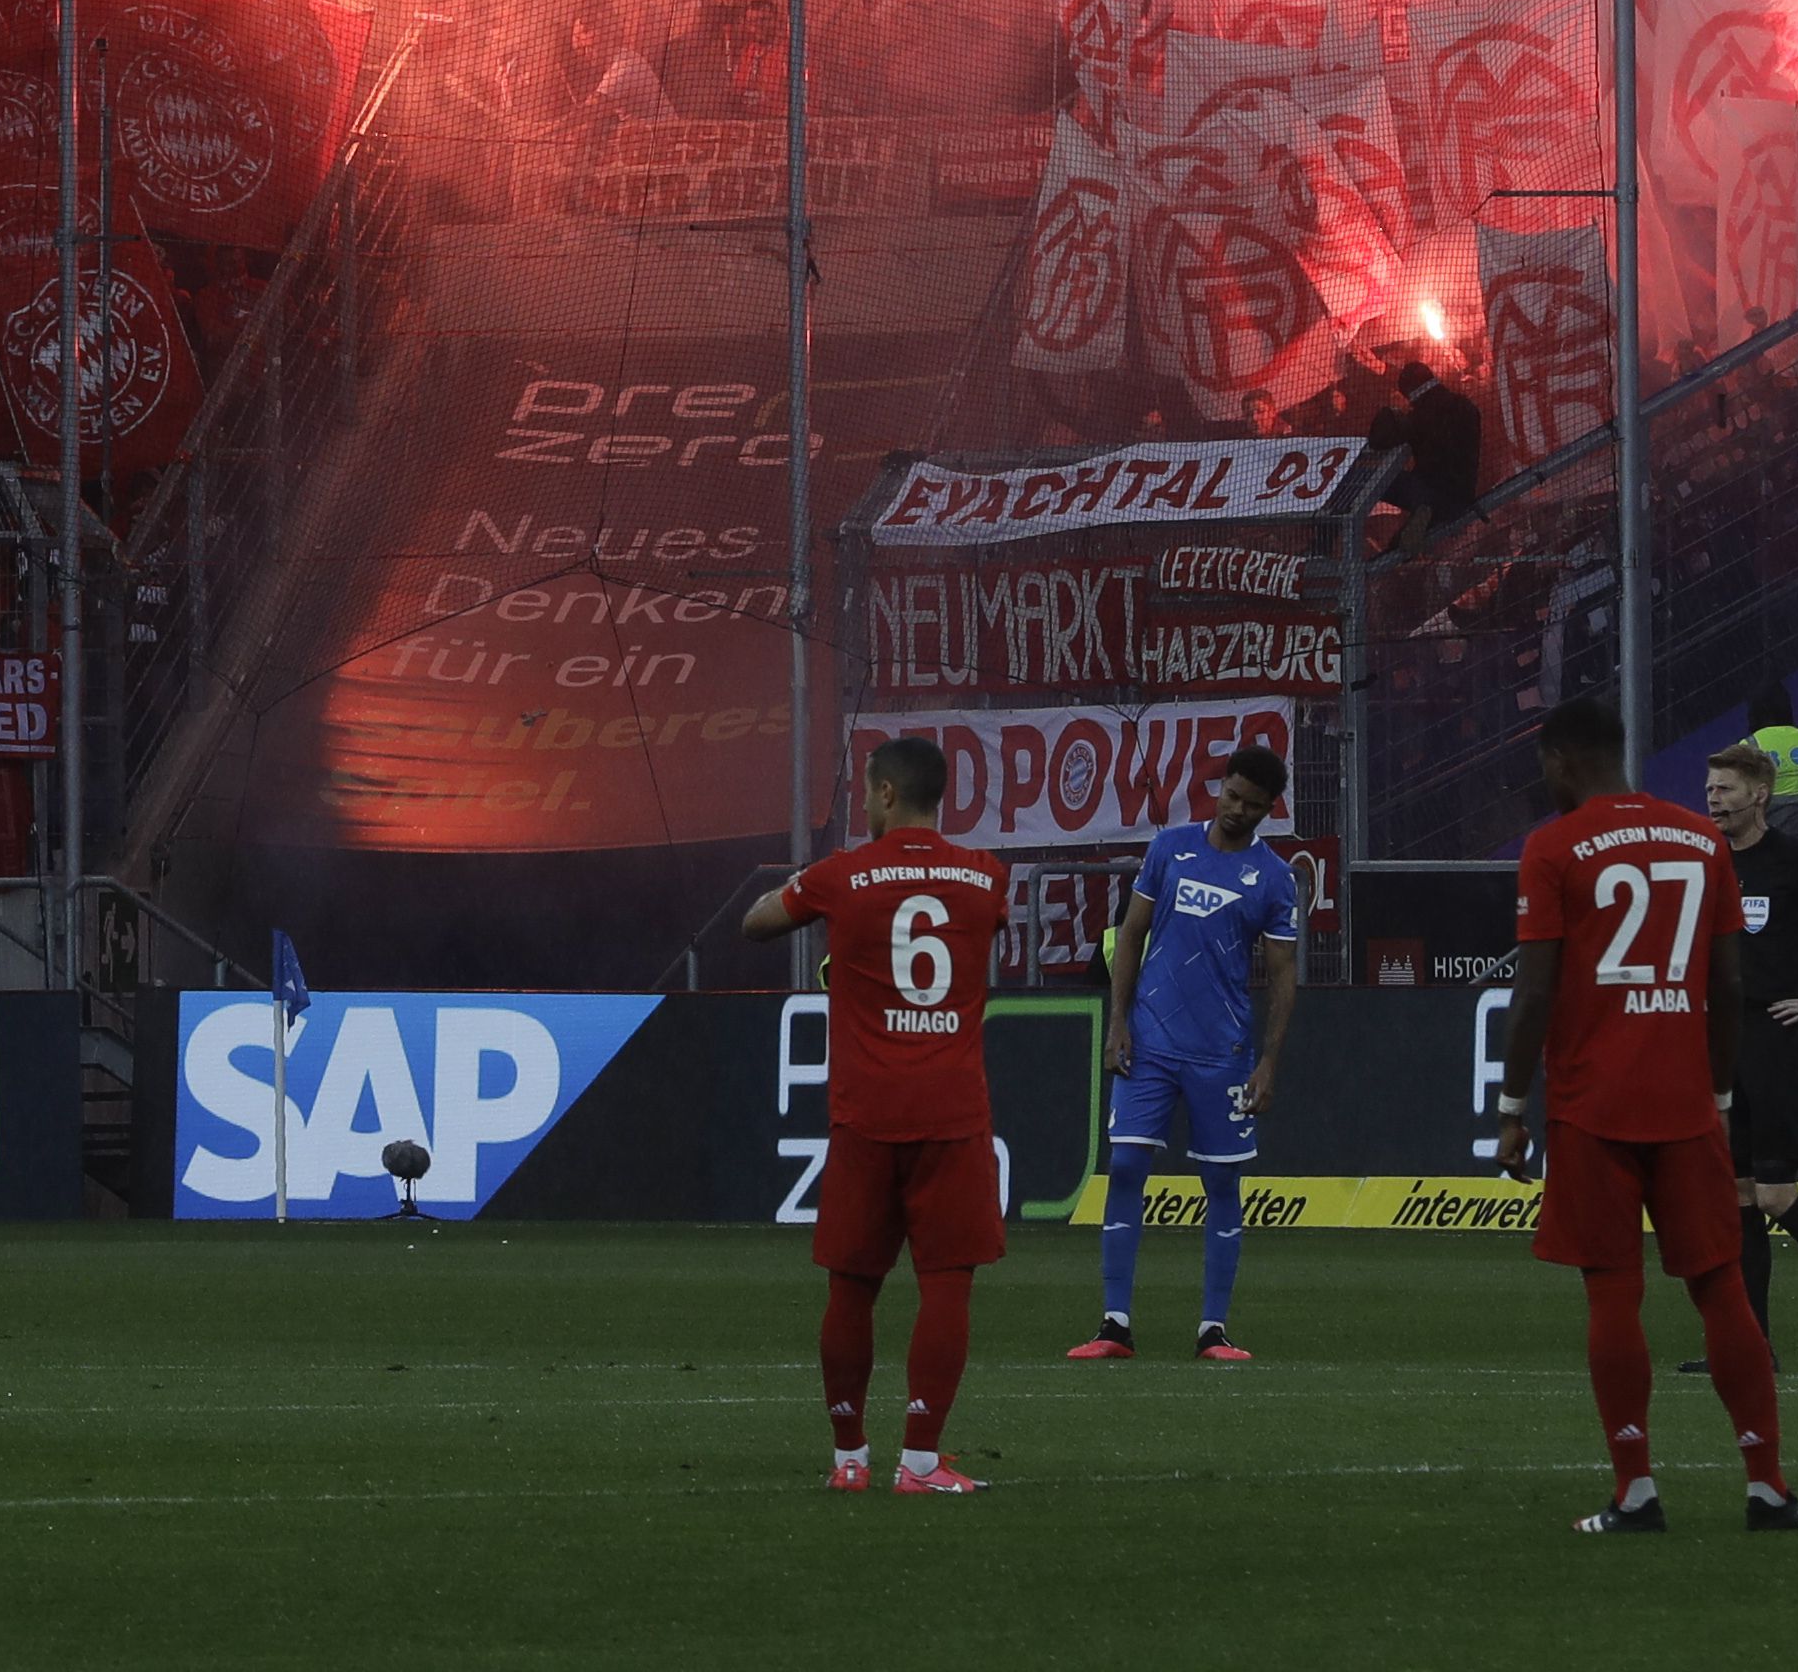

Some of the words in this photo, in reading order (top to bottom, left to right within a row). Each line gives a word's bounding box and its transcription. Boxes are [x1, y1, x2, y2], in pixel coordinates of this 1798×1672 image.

[122, 117, 221, 203] MÜNCHEN
[232, 158, 262, 189] E.V.
[6, 320, 35, 357] F.C.
[138, 340, 164, 384] E.V.
[512, 380, 758, 422] pre
[494, 429, 824, 467] zero
[1255, 446, 1351, 502] 93
[454, 509, 760, 562] Neues
[423, 573, 792, 625] Denken
[869, 564, 1147, 688] NEUMARKT
[390, 635, 531, 684] für
[553, 645, 700, 688] ein
[1140, 620, 1343, 686] HARZBURG
[1571, 842, 1595, 862] FC
[1595, 826, 1648, 853] BAYERN
[1650, 825, 1718, 857] MÜNCHEN
[849, 871, 871, 891] FC
[870, 865, 926, 884] BAYERN
[928, 865, 995, 893] MÜNCHEN
[1177, 885, 1224, 911] SAP
[1593, 860, 1707, 986] 27
[1742, 898, 1767, 910] FIFA
[890, 893, 953, 1008] 6
[1433, 954, 1519, 980] HISTORIS
[883, 1007, 960, 1035] THIAGO
[1623, 988, 1692, 1015] ALABA
[181, 1002, 563, 1203] SAP
